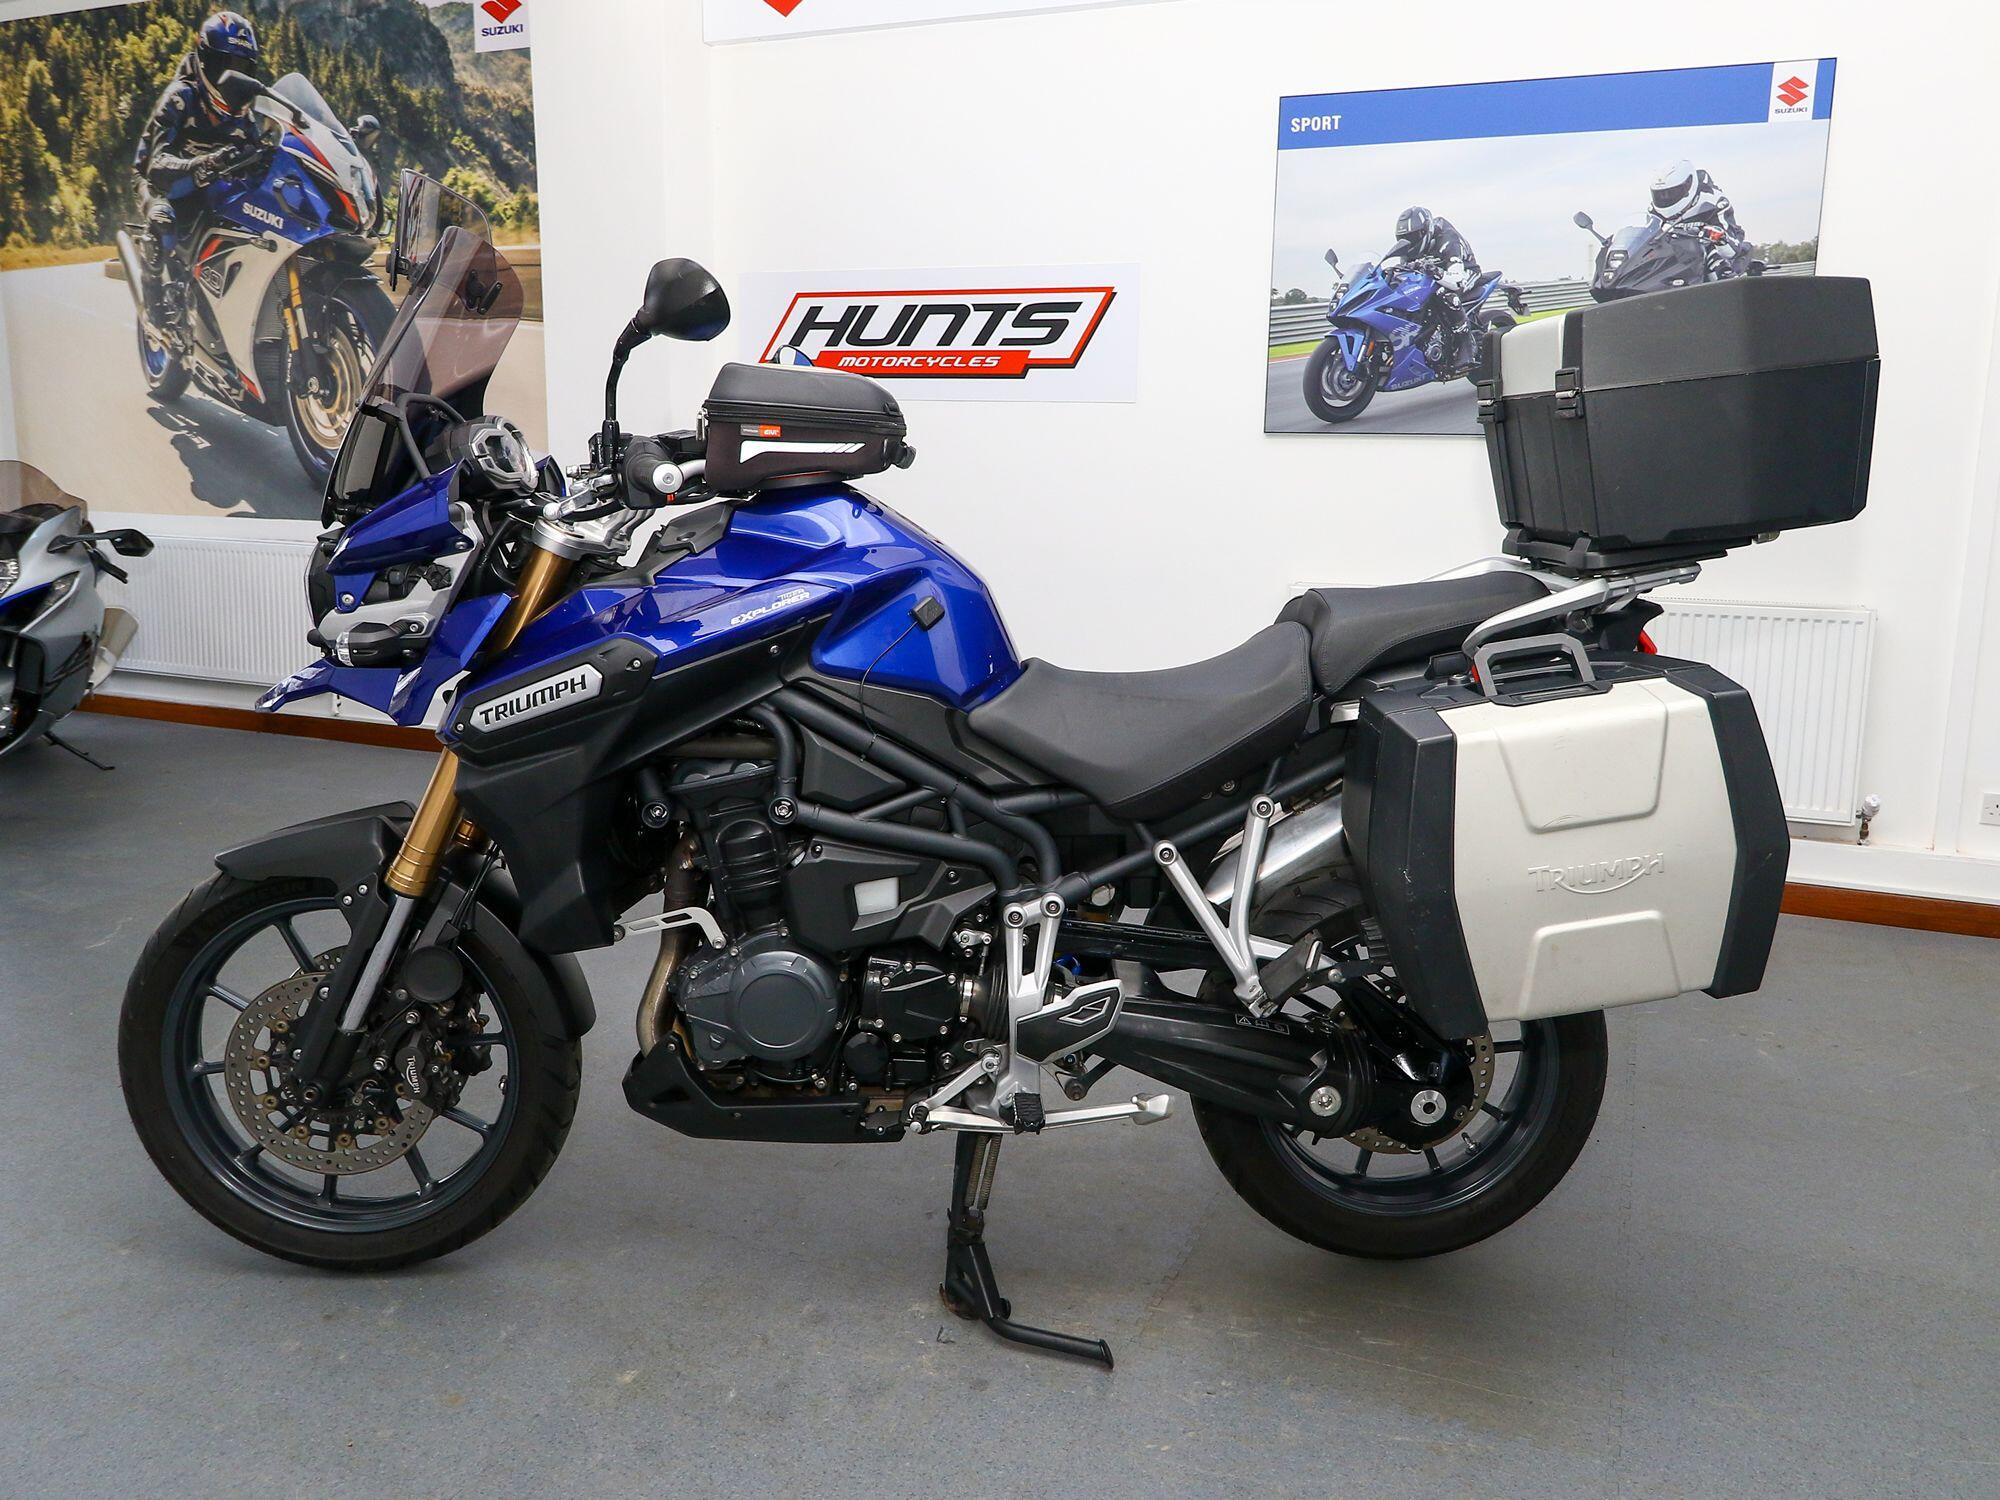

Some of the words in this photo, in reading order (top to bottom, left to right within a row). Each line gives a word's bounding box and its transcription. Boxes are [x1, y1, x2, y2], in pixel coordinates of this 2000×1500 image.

[481, 23, 524, 37] SUZUKI
[1290, 114, 1342, 133] SPORT
[1774, 106, 1808, 115] SUZUKI
[242, 202, 284, 229] SUZUKI
[789, 301, 1083, 347] HUNTS
[838, 355, 1002, 368] MOTORCYCLES
[479, 673, 588, 725] TRIUMPH
[1527, 851, 1665, 894] TRIUMPH
[406, 1056, 420, 1094] TRIUMPH
